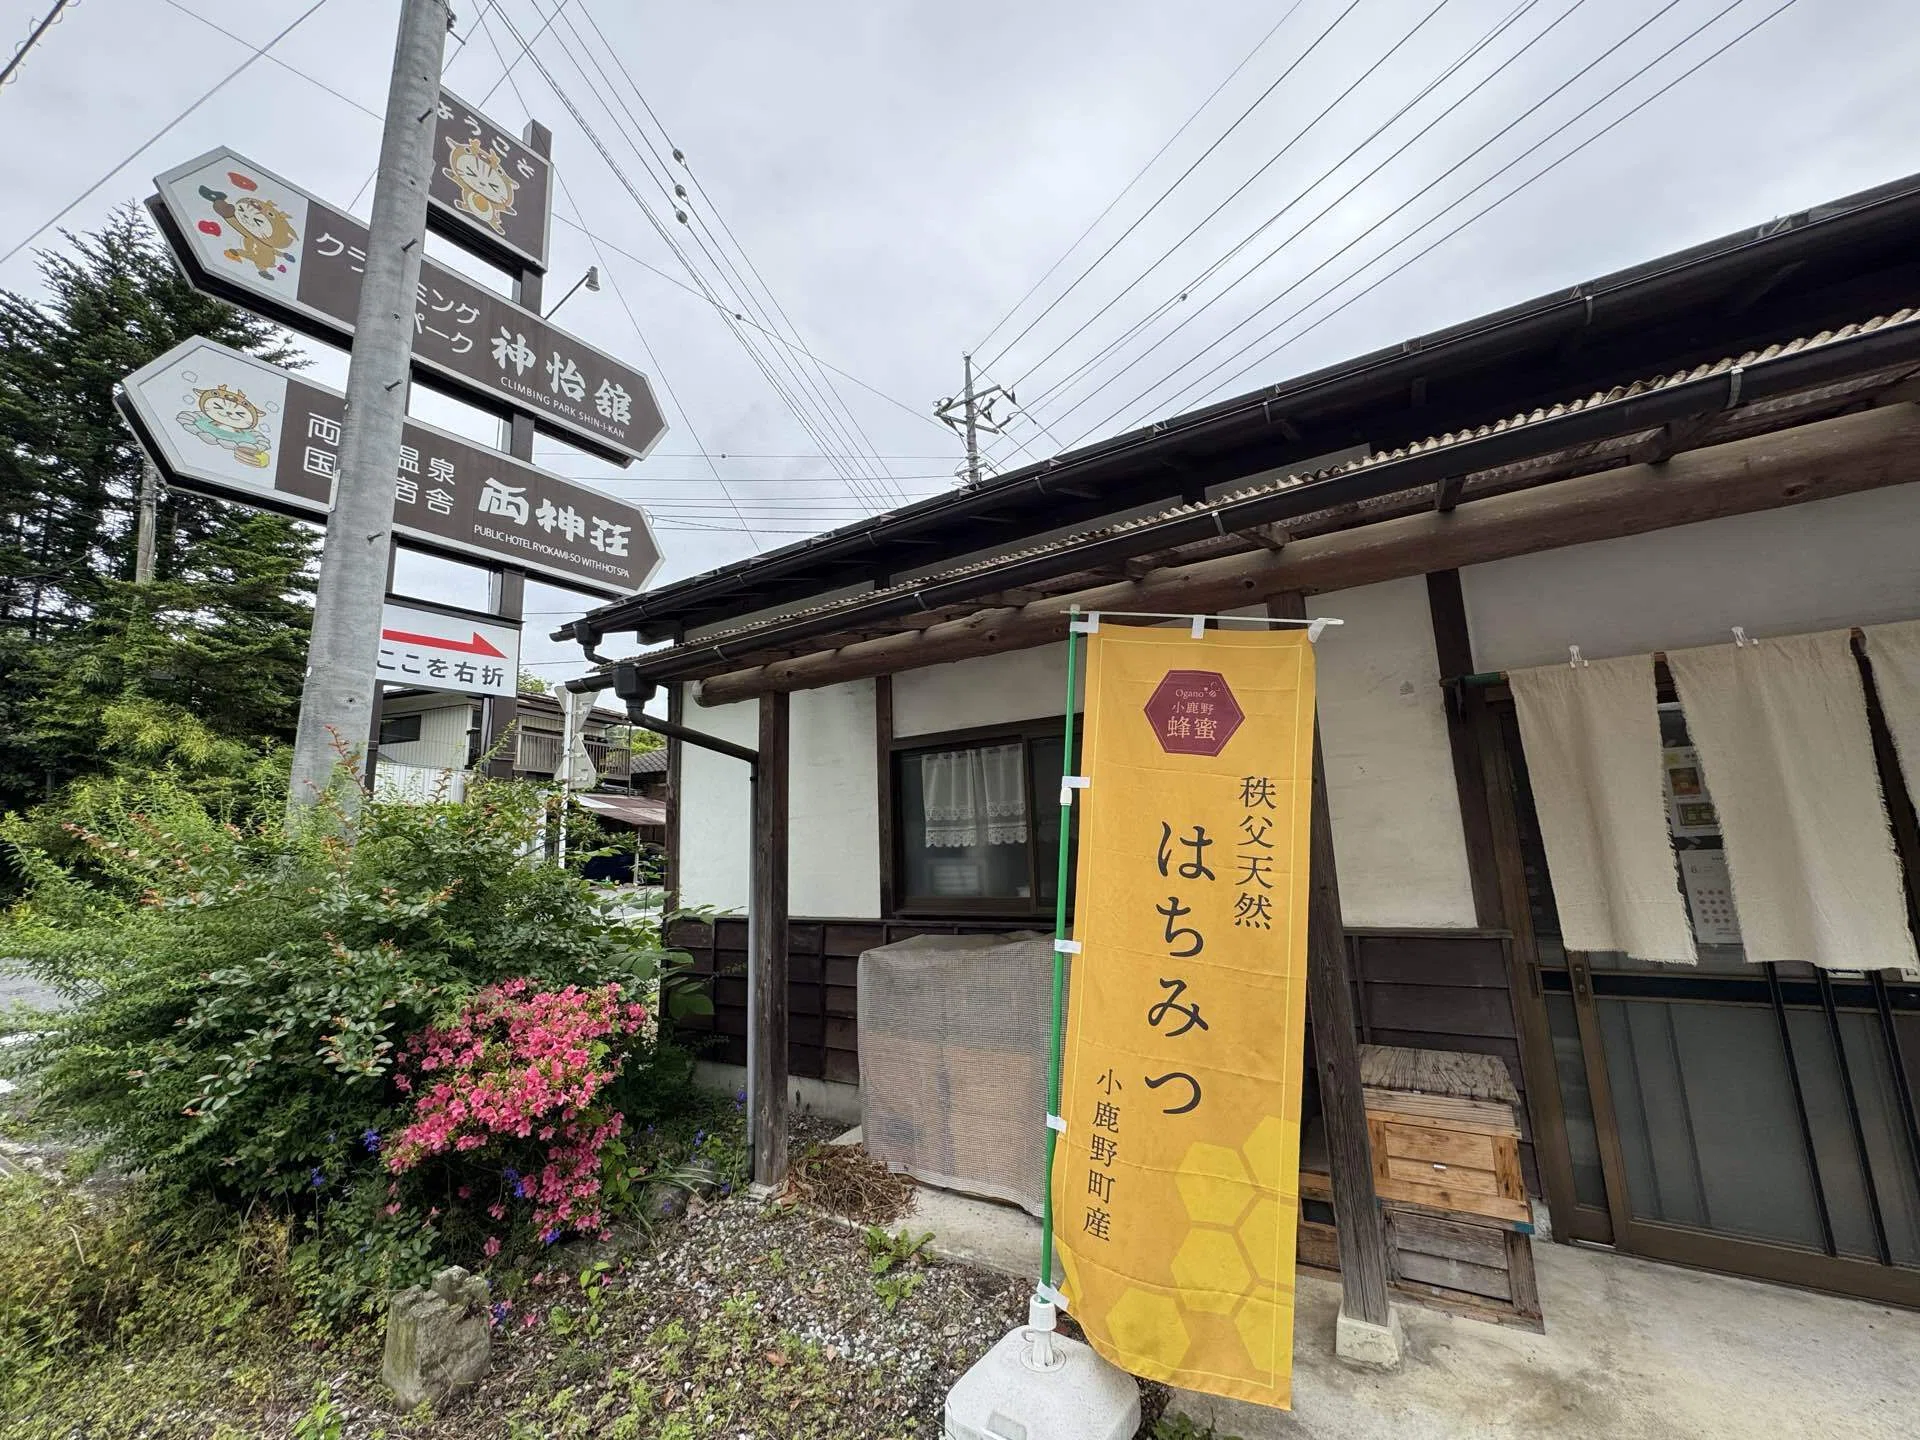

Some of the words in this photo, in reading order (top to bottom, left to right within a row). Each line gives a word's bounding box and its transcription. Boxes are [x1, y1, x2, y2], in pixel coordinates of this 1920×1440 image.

[437, 101, 535, 180] ようこそ
[501, 376, 550, 406] CLIMBING
[553, 400, 576, 417] PARK
[579, 411, 625, 439] SHIN-I-KAN
[474, 524, 505, 543] PUBLIC
[505, 535, 532, 550] HOTEL
[532, 541, 581, 564] RYOKAMI-SO
[581, 557, 602, 570] WITH
[478, 477, 631, 557] 両神荘
[377, 650, 504, 687] ここを右折
[1175, 689, 1204, 700] Ogano
[1167, 715, 1217, 741] 蜂蜜
[1171, 701, 1214, 716] 小鹿野
[1233, 775, 1276, 931] 秩父天然
[1145, 820, 1216, 1115] はちみつ
[1082, 1068, 1124, 1243] 小鹿野町産
